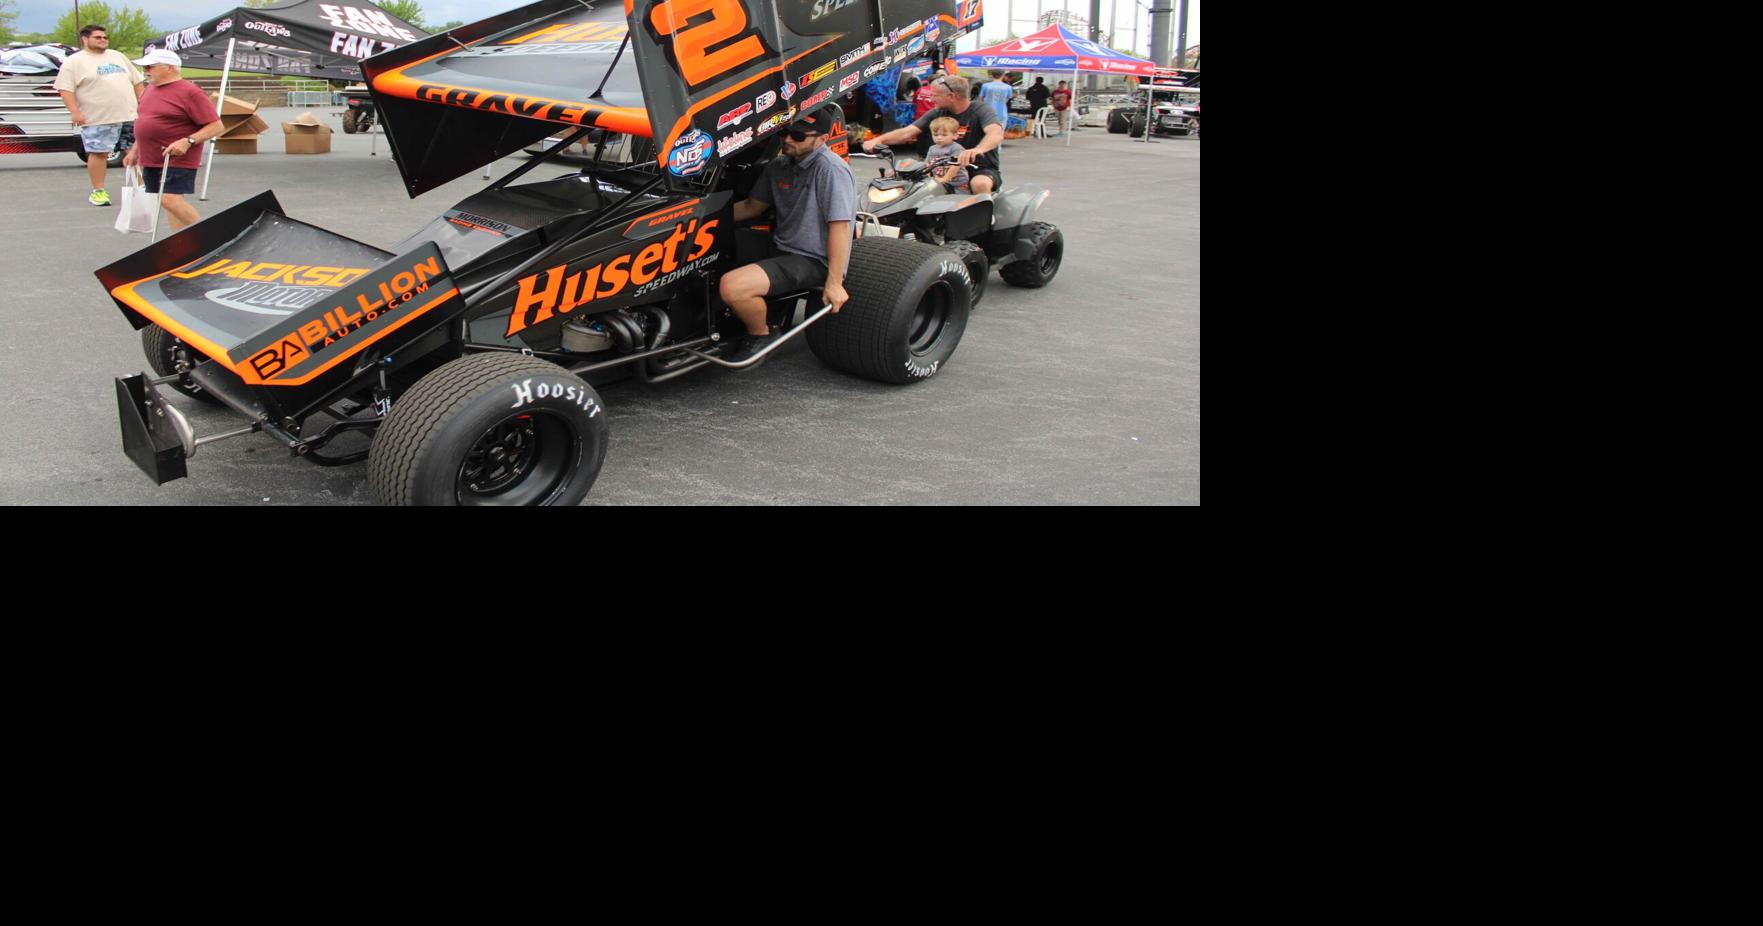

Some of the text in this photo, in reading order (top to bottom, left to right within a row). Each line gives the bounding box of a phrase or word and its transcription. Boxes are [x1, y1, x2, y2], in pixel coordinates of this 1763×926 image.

[319, 4, 395, 27] FAN
[319, 15, 418, 42] ZONE
[330, 32, 376, 58] FAN
[650, 0, 766, 87] 2
[505, 219, 719, 337] Huset's
[634, 252, 719, 297] SPEEDWAY.COM
[299, 256, 441, 346] BILLION
[323, 282, 429, 347] AUTO.COM
[250, 339, 304, 380] BA
[511, 378, 601, 418] Hoosier
